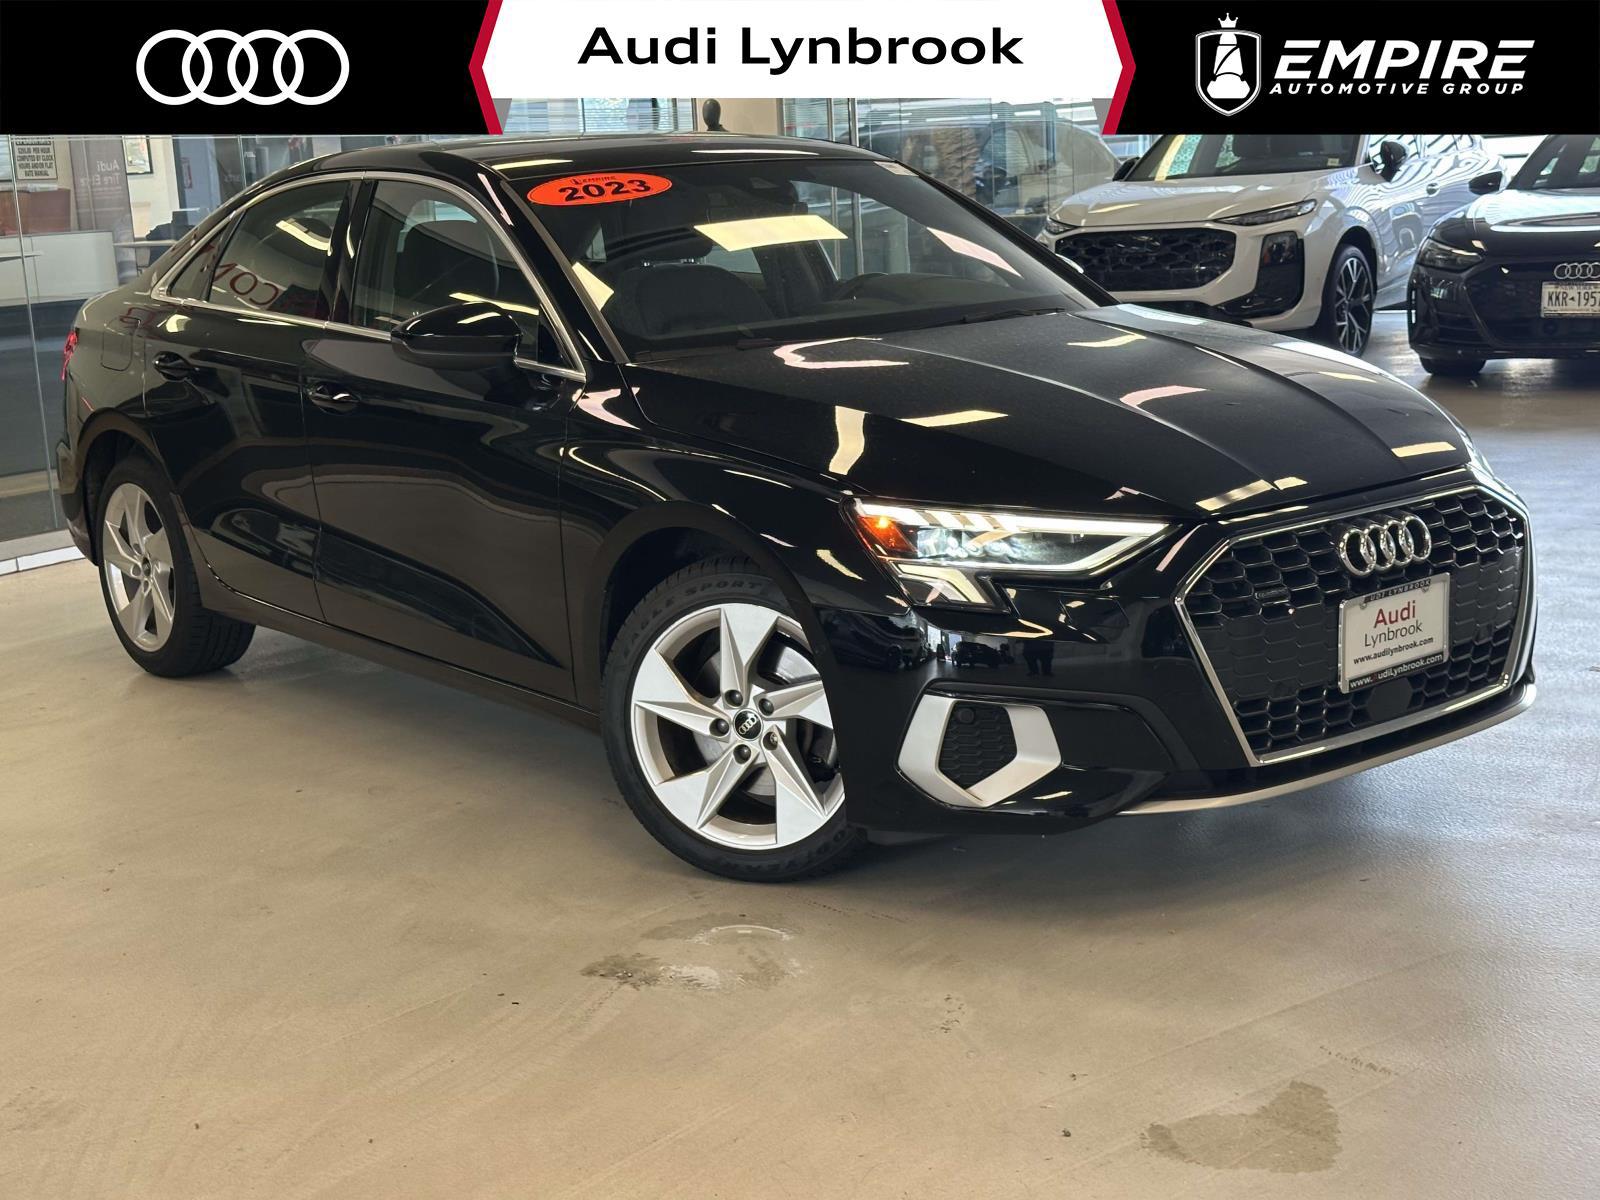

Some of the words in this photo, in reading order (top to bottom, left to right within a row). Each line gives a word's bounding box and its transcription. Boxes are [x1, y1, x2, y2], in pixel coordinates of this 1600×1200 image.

[558, 179, 652, 202] 2023
[684, 580, 762, 596] SPORT
[1388, 580, 1431, 596] LYNBROOK
[1373, 600, 1416, 628] Audi
[1364, 620, 1423, 648] Lynbrook
[1353, 636, 1434, 664] www.audilynbrook.com
